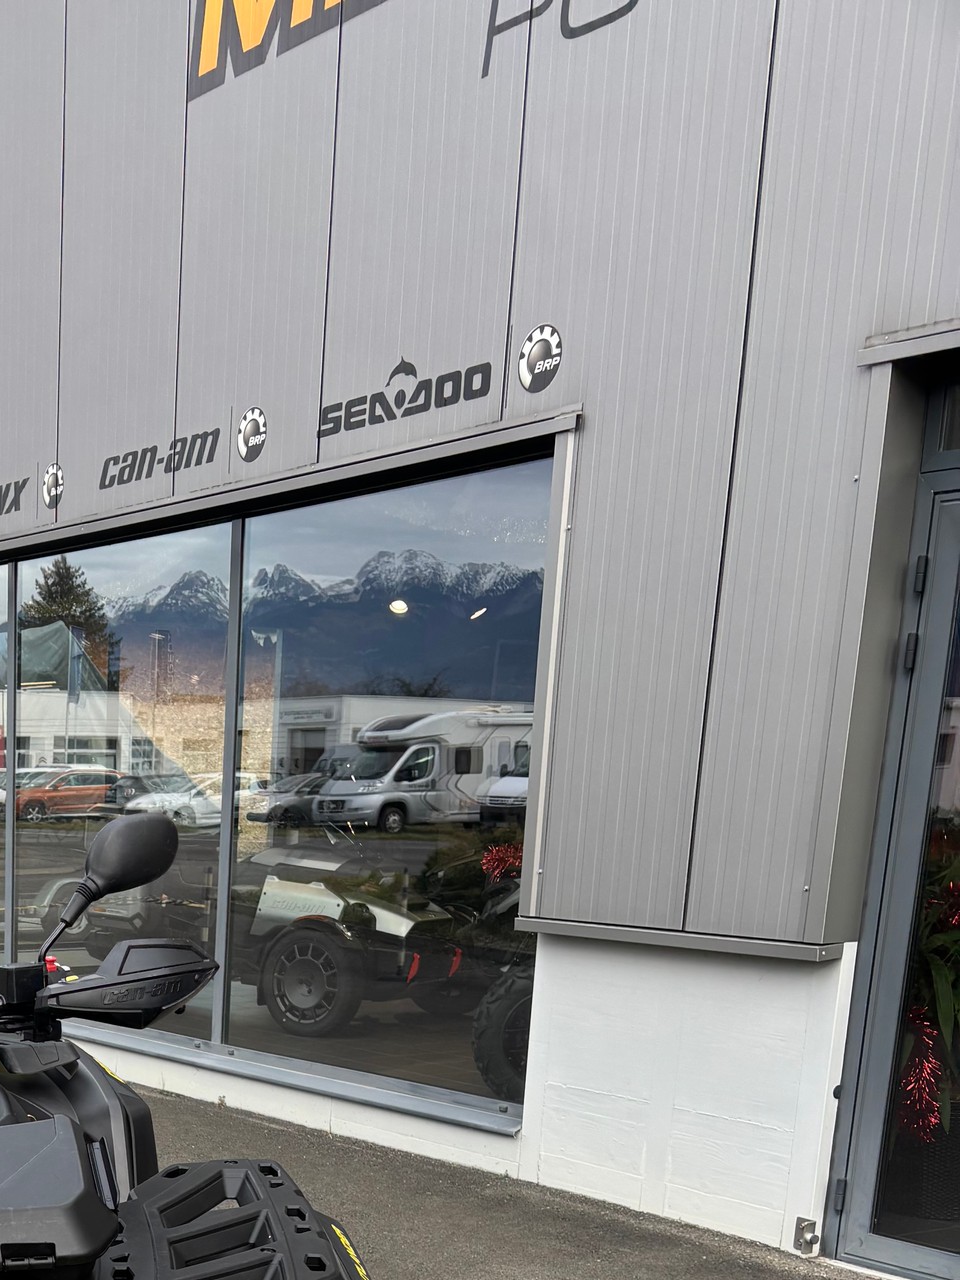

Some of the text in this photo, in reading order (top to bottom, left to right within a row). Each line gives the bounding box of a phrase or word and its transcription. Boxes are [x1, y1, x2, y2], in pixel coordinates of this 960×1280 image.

[534, 356, 560, 374] BRP
[248, 433, 266, 447] BRP
[99, 427, 220, 490] can-am
